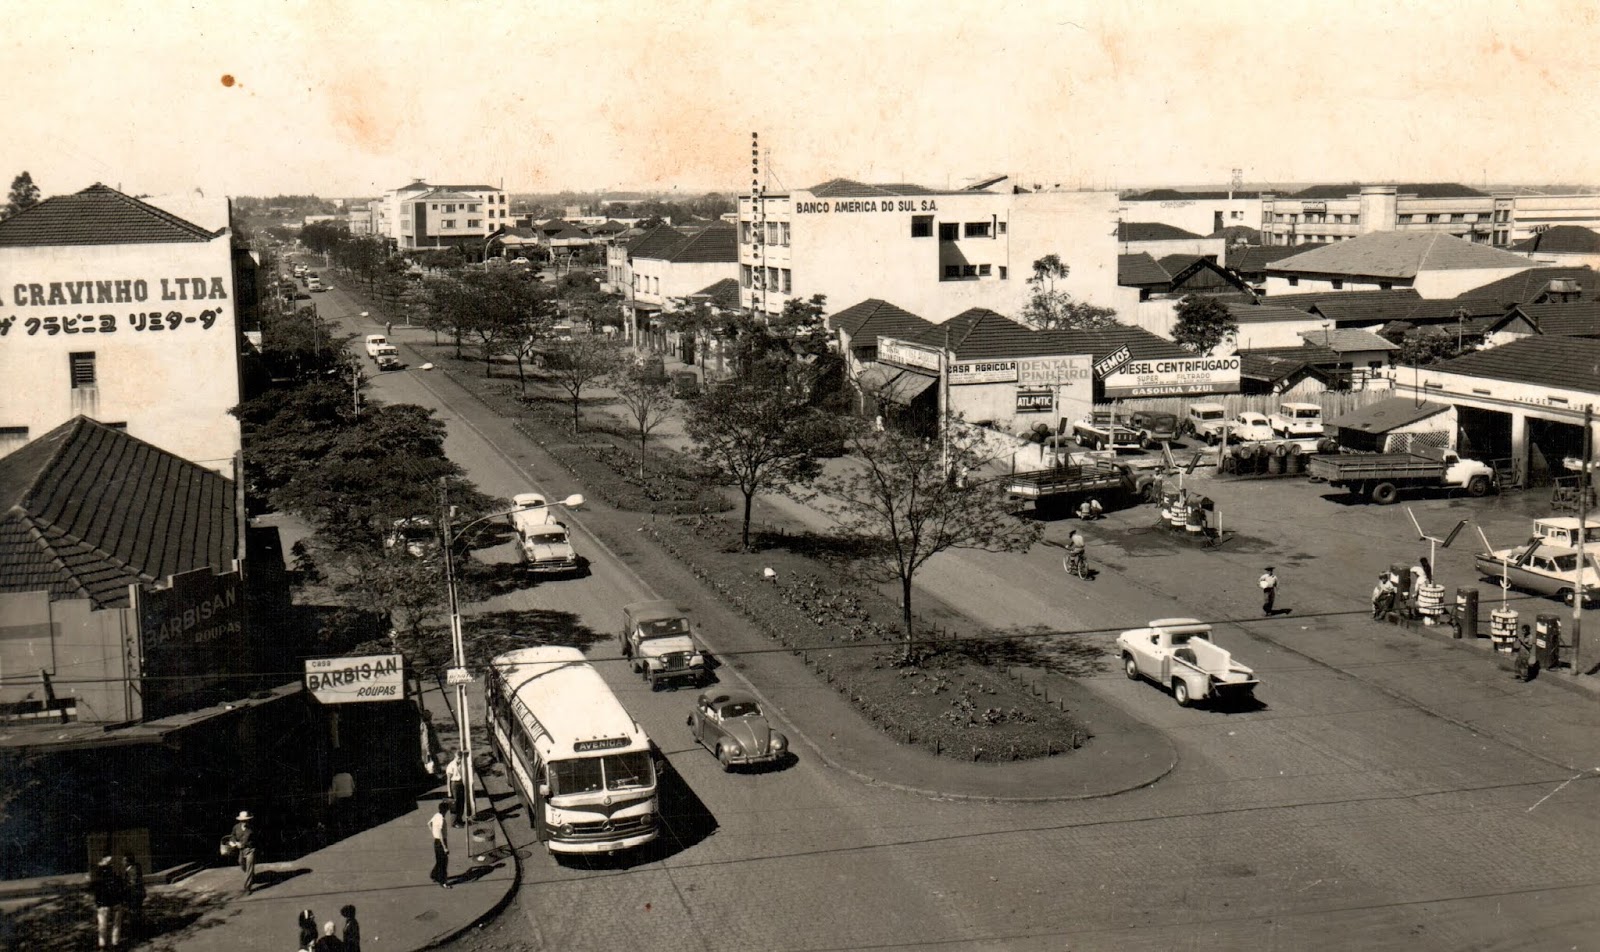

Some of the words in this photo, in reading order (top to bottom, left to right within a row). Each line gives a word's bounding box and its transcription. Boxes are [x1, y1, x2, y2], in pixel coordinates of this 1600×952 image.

[796, 202, 829, 214] BANCO
[834, 201, 877, 213] AMERICA
[881, 201, 895, 212] DO
[898, 200, 916, 212] SUL
[921, 199, 939, 212] S.A.
[13, 278, 149, 307] CRAVINHO
[160, 276, 228, 301] LTDA
[975, 361, 1016, 373] AGRICOLA
[1021, 358, 1078, 371] DENTAL
[1095, 346, 1131, 377] TEMOS
[1119, 362, 1155, 375] DIESEL
[1156, 359, 1240, 374] CENTRIFUGADO
[1021, 368, 1089, 381] PINHEIRO
[1137, 374, 1159, 382] SUPER
[1177, 372, 1211, 380] FILTRADO
[1132, 385, 1183, 396] GASOLINA
[1188, 384, 1214, 393] AZUL
[1017, 396, 1052, 407] ATLANTIC
[145, 586, 236, 650] BARBISAN
[194, 620, 242, 643] ROUPAS
[308, 656, 398, 691] BARBISAN
[357, 685, 397, 697] ROUPAS
[579, 740, 623, 751] AVENIDA
